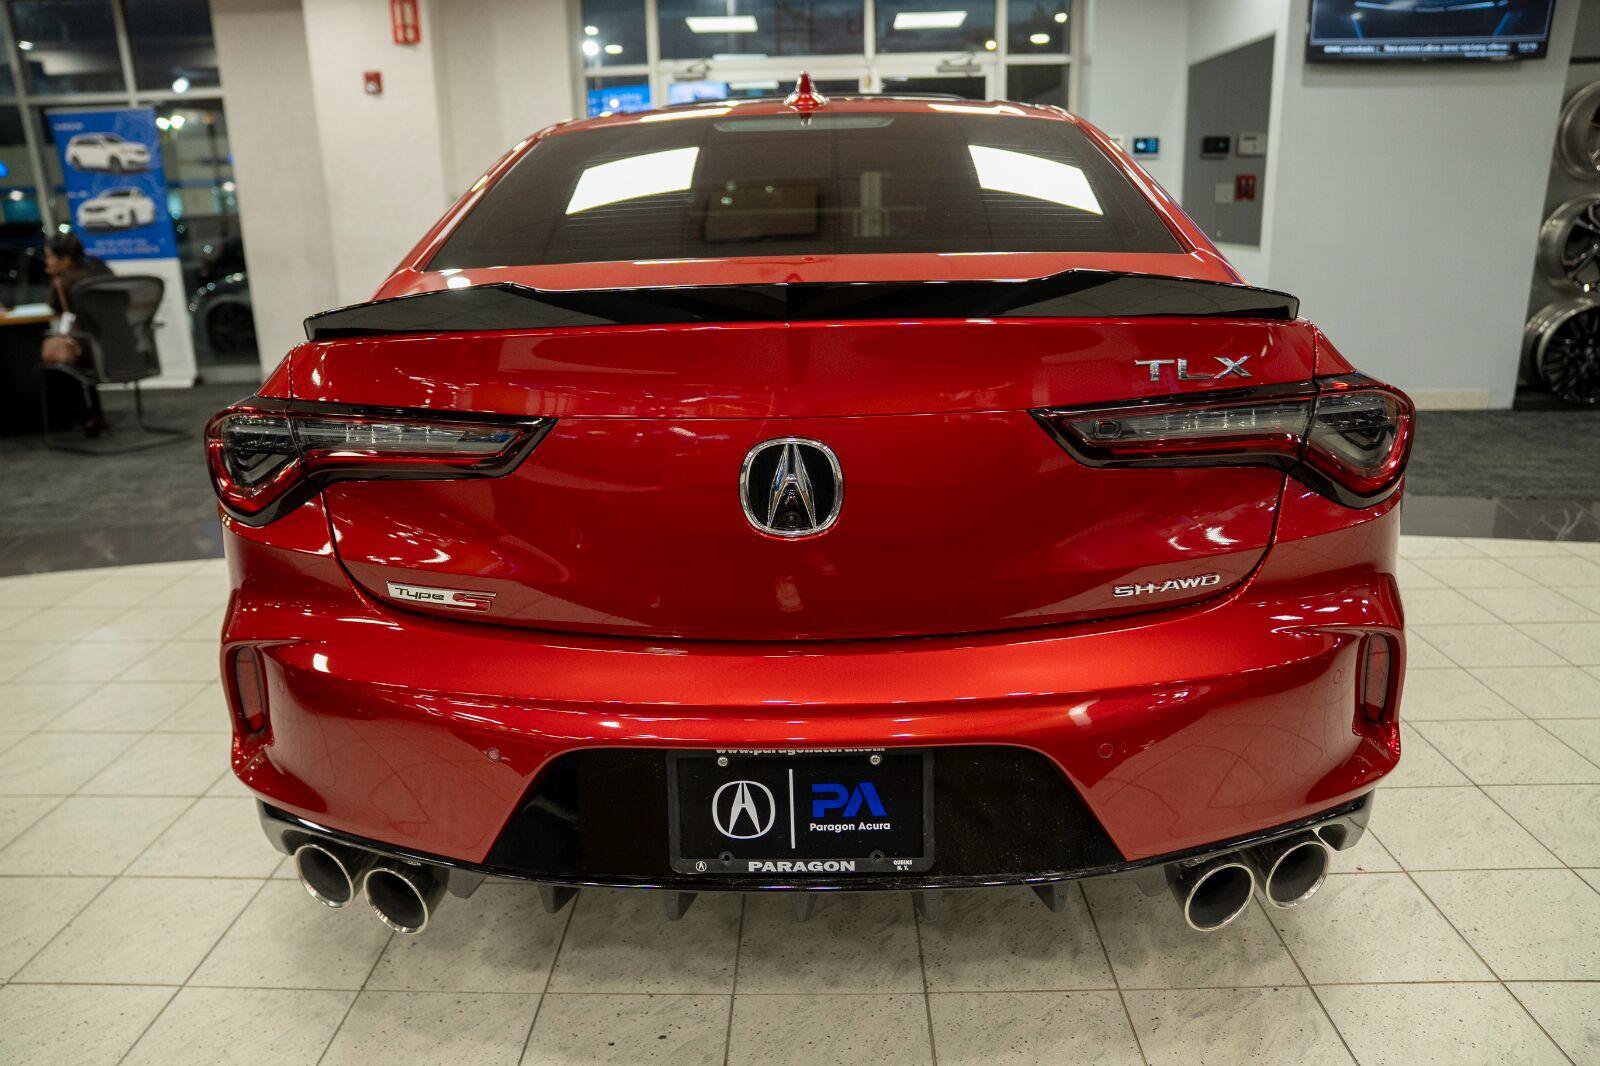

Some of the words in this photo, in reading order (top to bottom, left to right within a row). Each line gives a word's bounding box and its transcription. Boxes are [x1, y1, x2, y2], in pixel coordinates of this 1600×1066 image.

[1134, 355, 1252, 381] TLX
[811, 782, 887, 818] PA
[809, 822, 856, 833] Paragon
[858, 821, 891, 831] Acura
[748, 860, 856, 872] PARAGON
